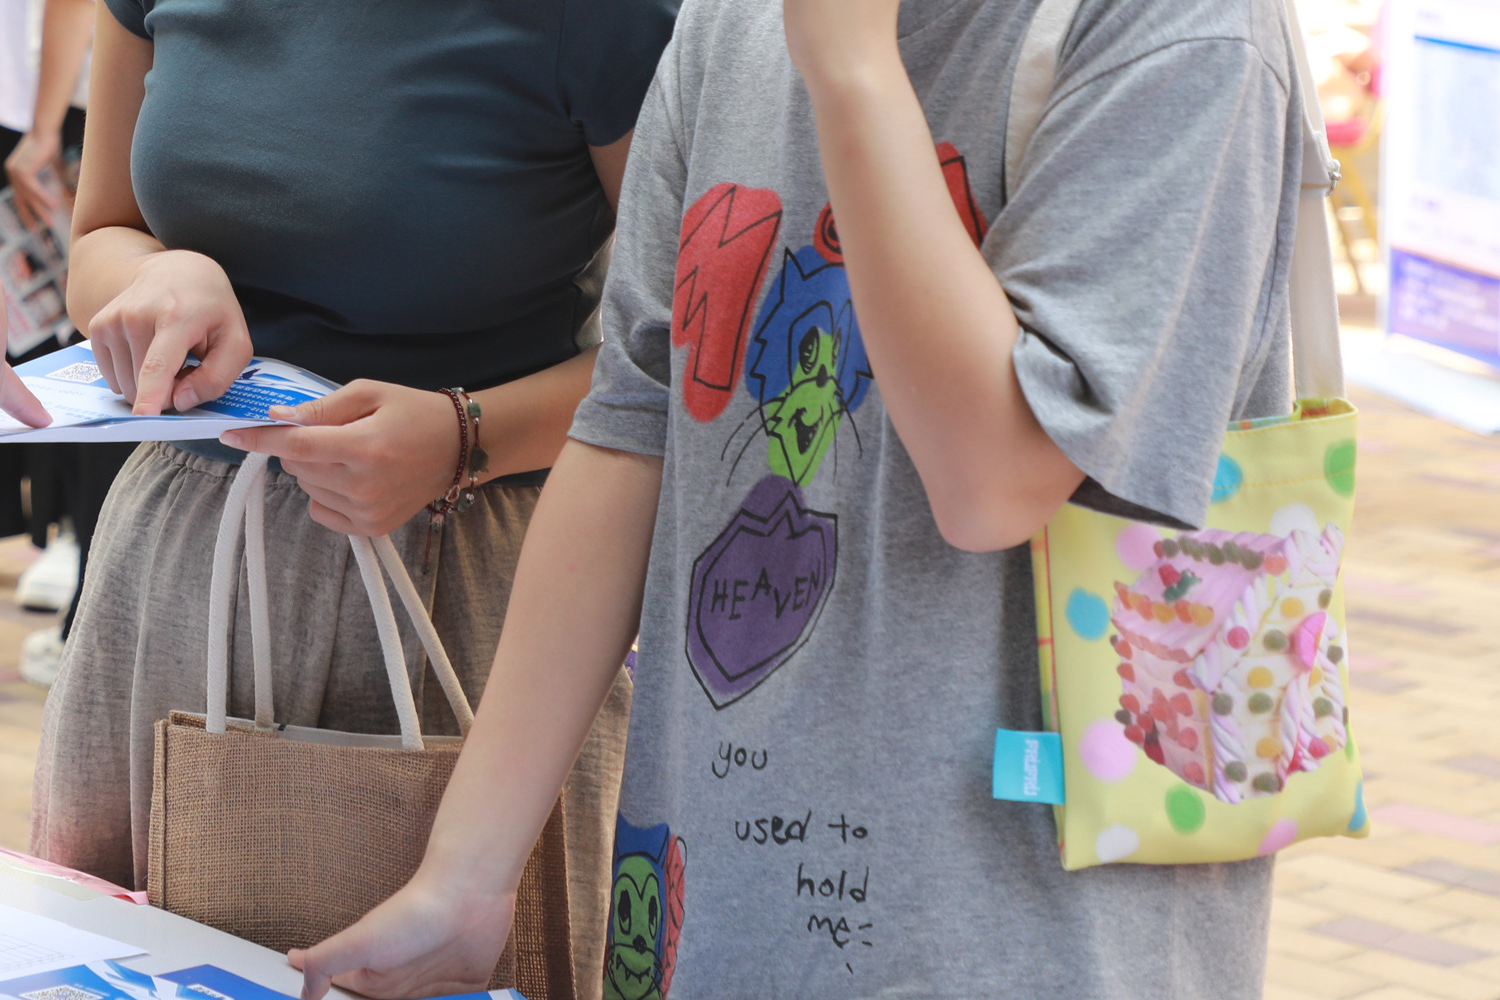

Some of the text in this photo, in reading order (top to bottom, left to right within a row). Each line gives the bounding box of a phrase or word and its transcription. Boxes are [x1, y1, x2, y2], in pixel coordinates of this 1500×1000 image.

[710, 560, 822, 622] HEAVEN
[711, 740, 769, 779] you
[735, 810, 869, 845] used to
[797, 863, 870, 903] hold
